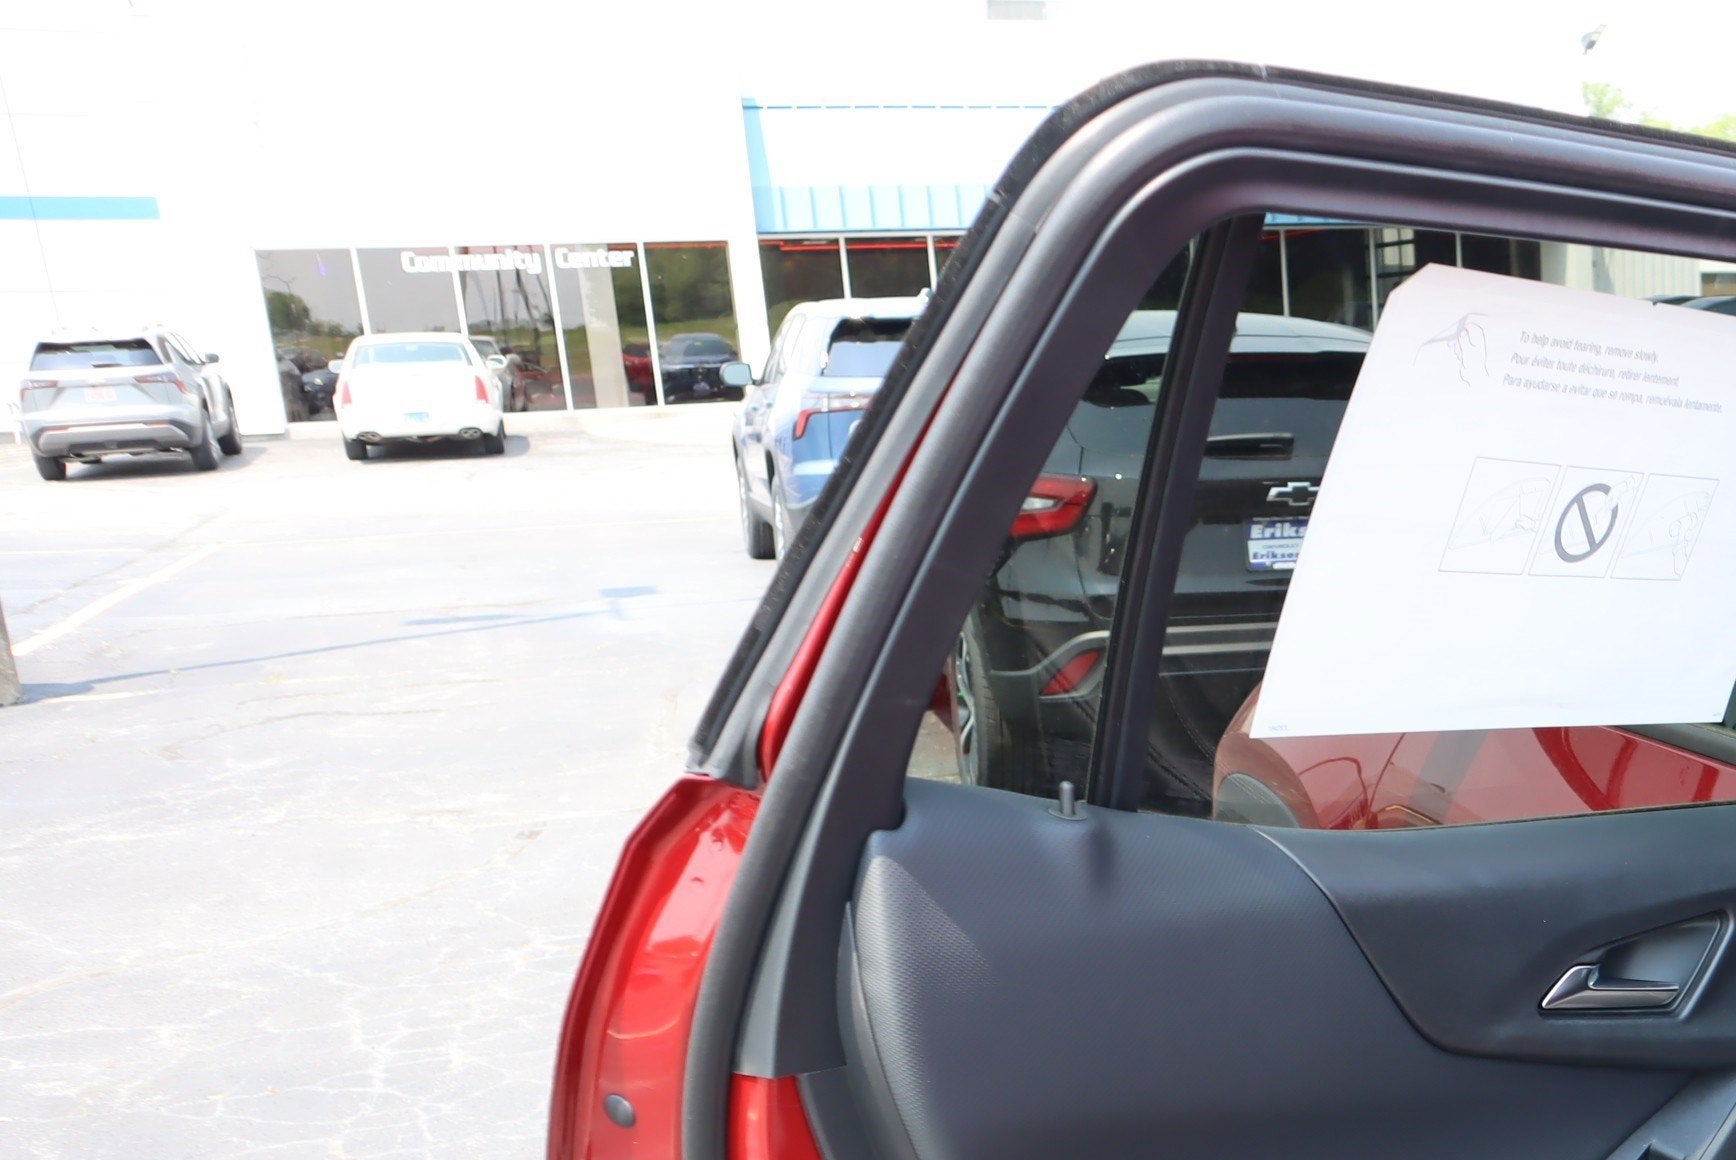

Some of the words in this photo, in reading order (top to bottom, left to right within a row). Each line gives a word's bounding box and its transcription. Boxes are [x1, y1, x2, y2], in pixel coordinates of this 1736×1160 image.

[400, 247, 543, 275] Community
[555, 247, 635, 269] Center
[1519, 330, 1531, 344] To
[1531, 332, 1550, 349] help
[1550, 336, 1574, 350] avoid
[1573, 340, 1603, 357] tearing,
[1604, 344, 1634, 359] remove
[1634, 348, 1660, 365] slowly.
[1510, 351, 1531, 367] Pour
[1556, 358, 1578, 373] toute
[1617, 368, 1643, 382] retirer
[1502, 372, 1523, 388] Para
[1523, 374, 1561, 393] ayudarse
[1568, 382, 1592, 398] evitar
[1592, 387, 1608, 400] que
[1608, 388, 1618, 400] se
[1250, 521, 1308, 539] Eriks
